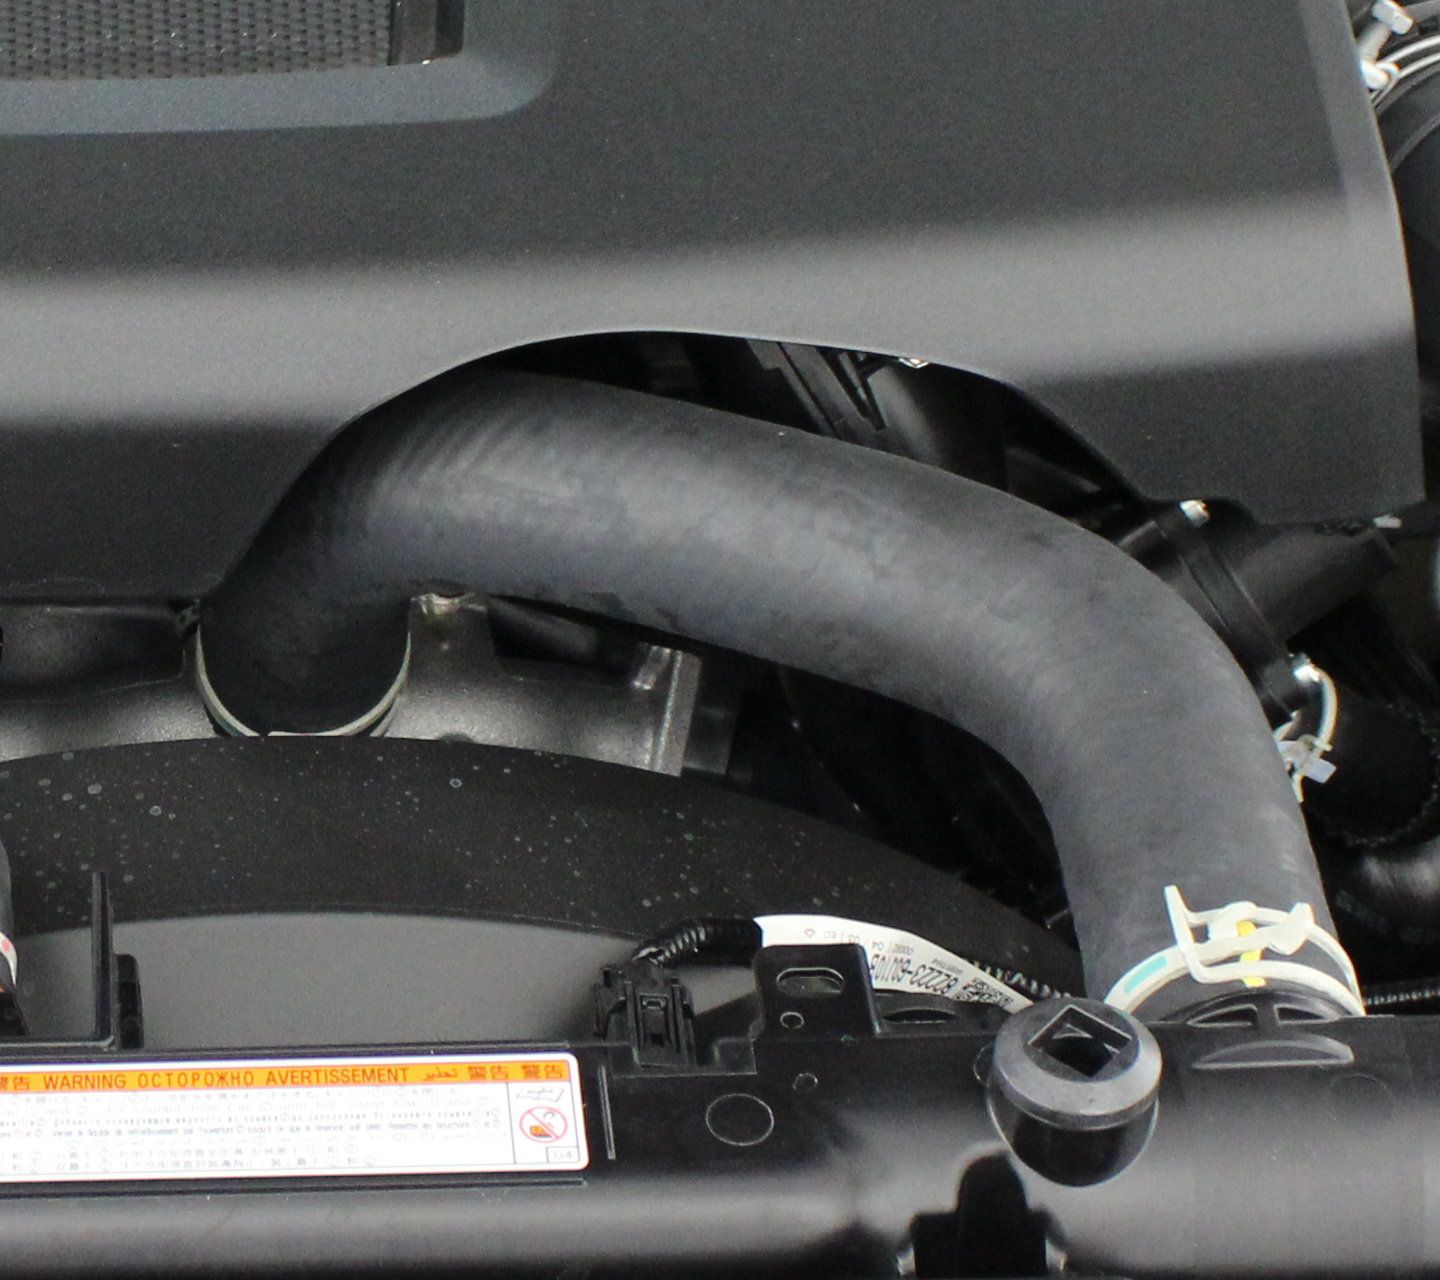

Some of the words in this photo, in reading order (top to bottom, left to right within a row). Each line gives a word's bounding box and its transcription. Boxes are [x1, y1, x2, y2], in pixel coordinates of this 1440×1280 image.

[43, 1073, 127, 1090] WARNING
[137, 1070, 255, 1087] ОСТОРОЖНО
[265, 1067, 410, 1085] AVERTISSEMENT
